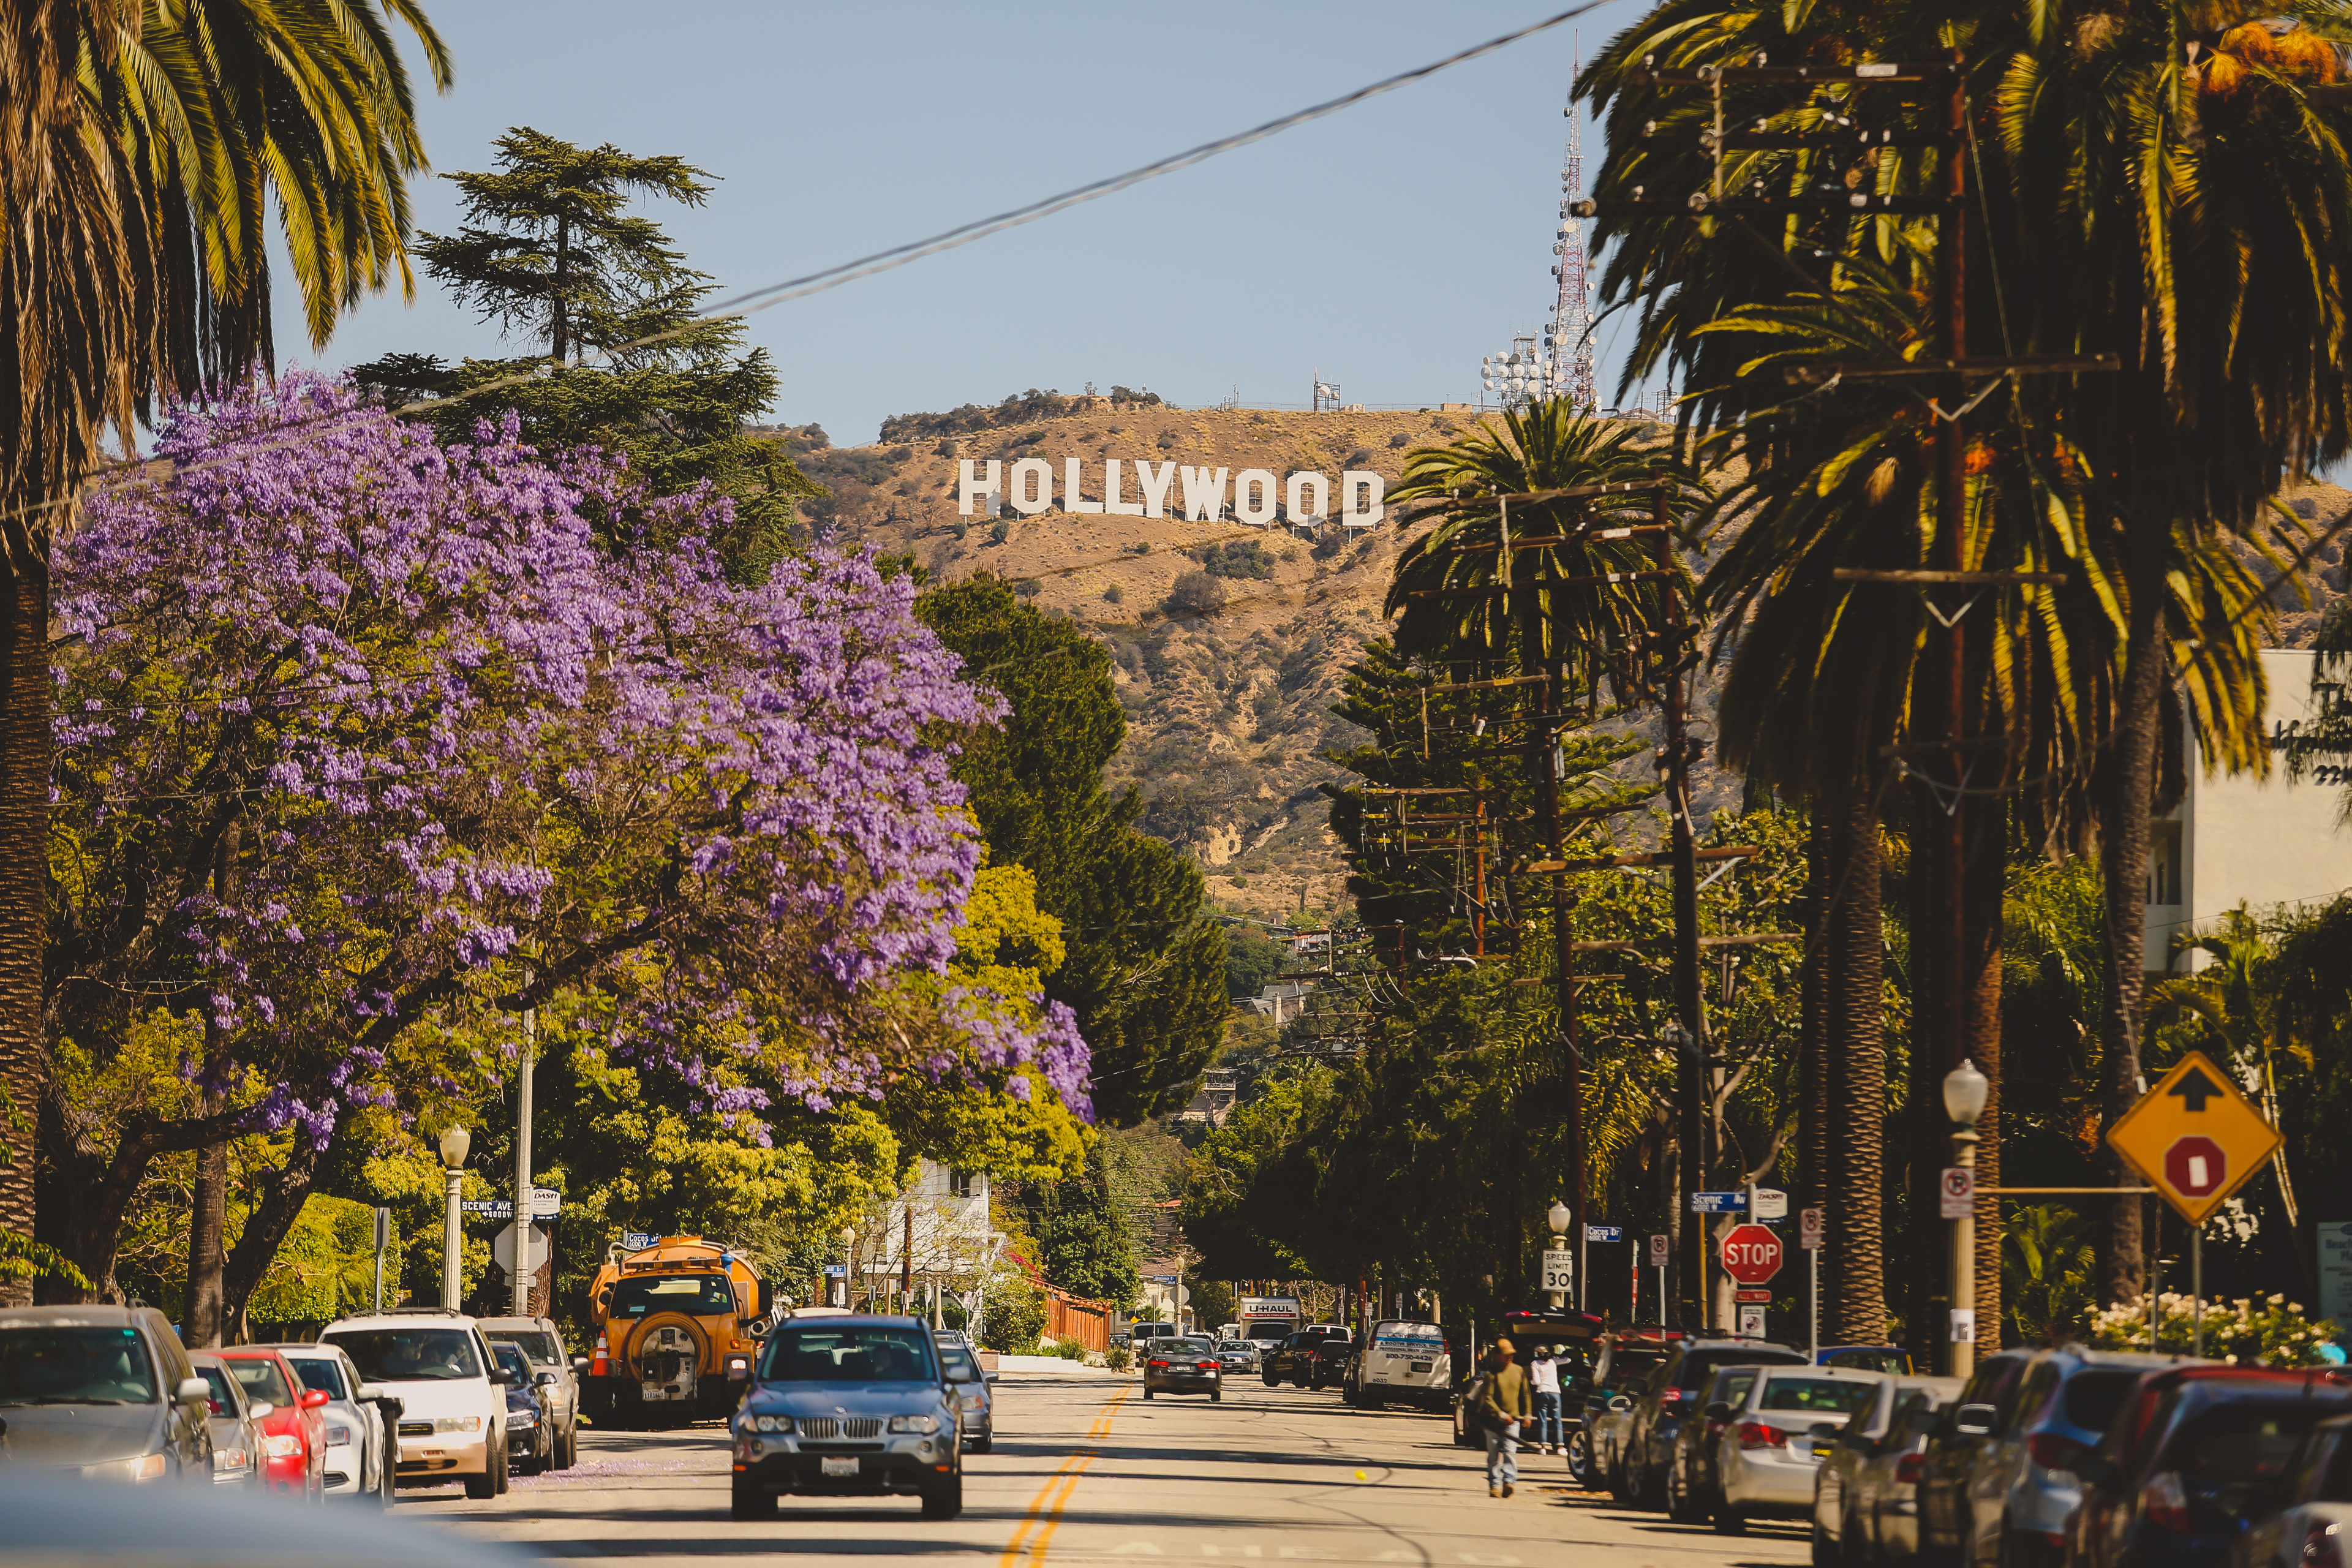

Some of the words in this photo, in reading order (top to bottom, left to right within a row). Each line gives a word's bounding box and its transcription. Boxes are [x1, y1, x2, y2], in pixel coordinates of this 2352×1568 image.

[959, 457, 1384, 527] HOLLYWOOD
[1692, 1194, 1722, 1204] Scenic
[1733, 1194, 1746, 1204] Av
[462, 1202, 492, 1210] SCENIC
[1589, 1227, 1608, 1235] Cocos
[1726, 1243, 1778, 1265] STOP
[1547, 1272, 1570, 1287] 30
